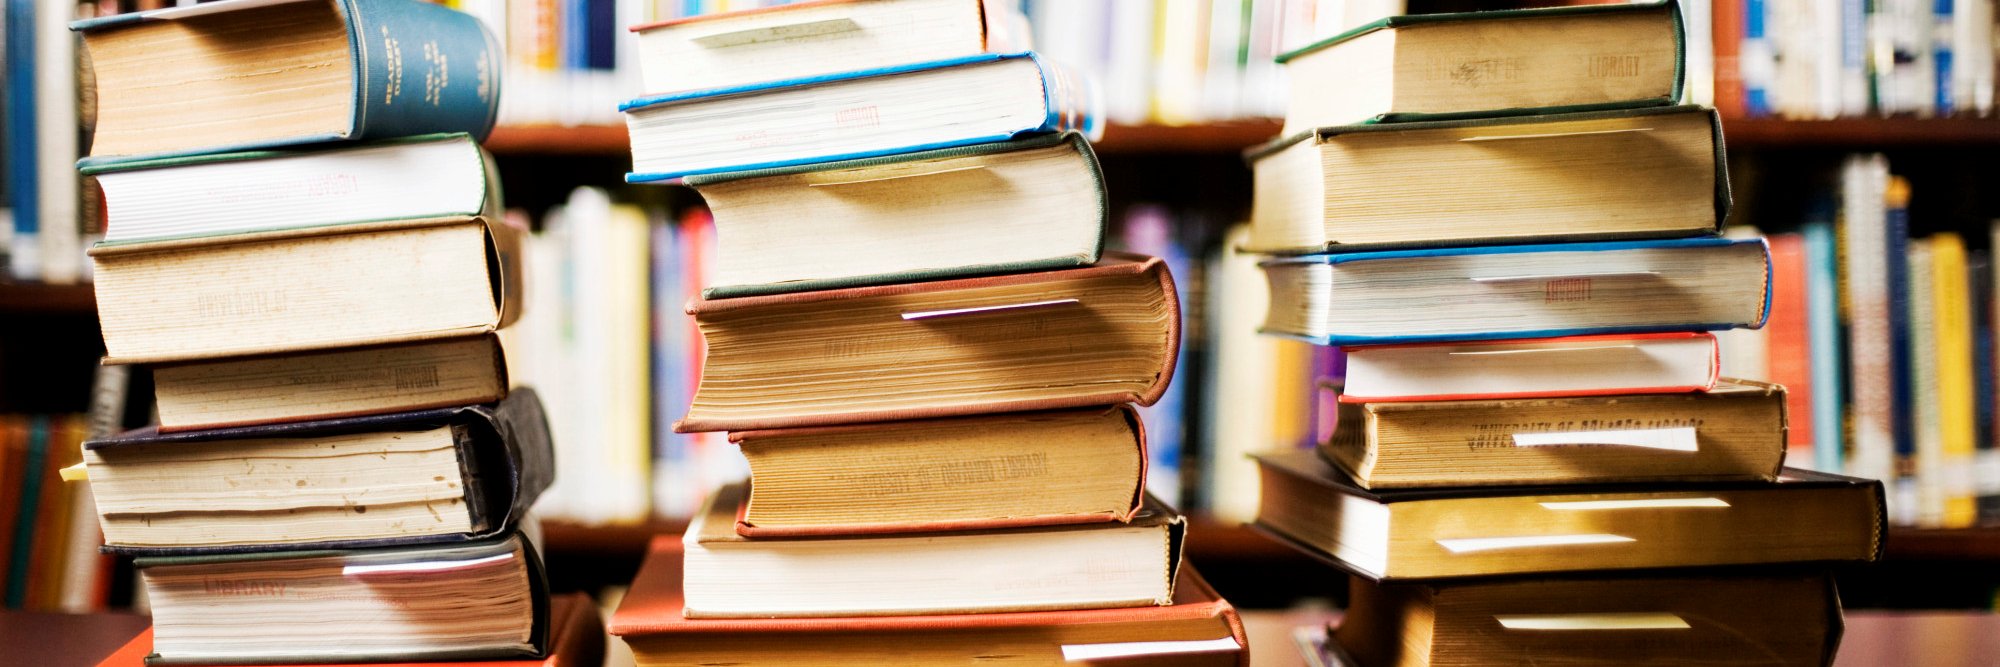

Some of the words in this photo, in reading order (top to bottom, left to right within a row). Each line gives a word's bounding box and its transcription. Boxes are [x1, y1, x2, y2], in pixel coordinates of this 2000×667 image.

[392, 38, 402, 96] DIGEST
[1588, 55, 1641, 78] LIBRARY
[204, 576, 287, 598] LIBRARY
